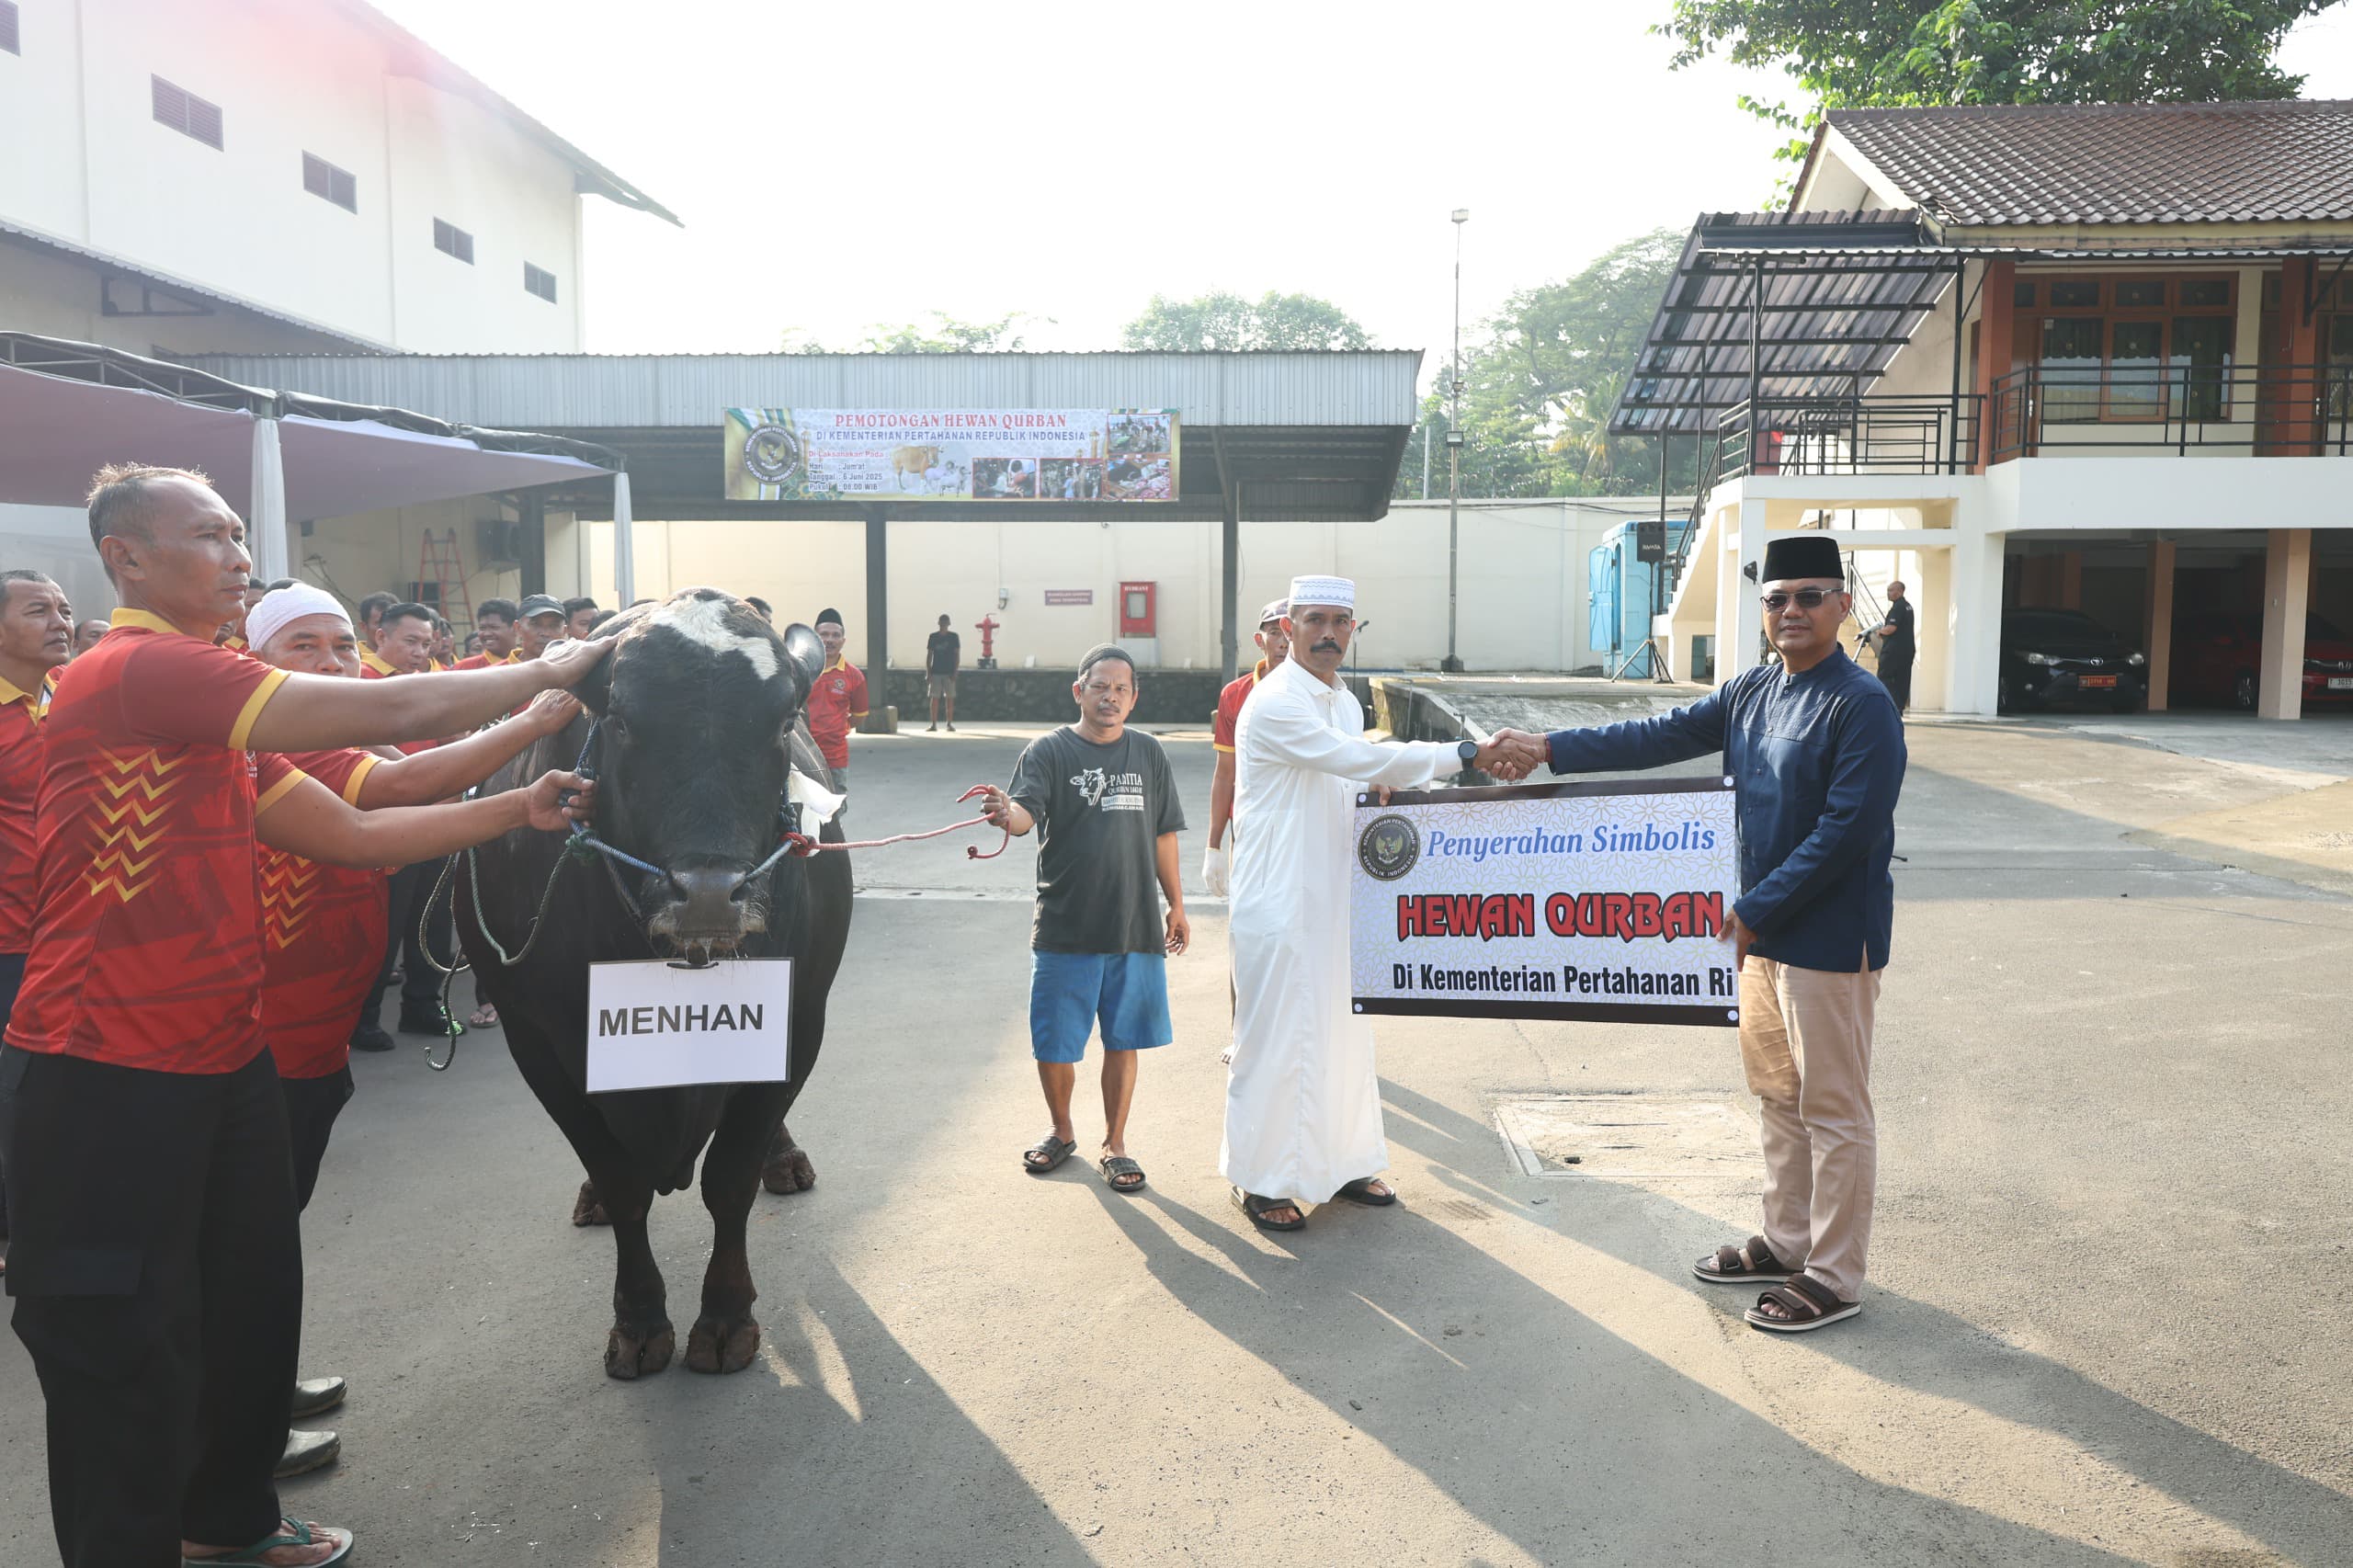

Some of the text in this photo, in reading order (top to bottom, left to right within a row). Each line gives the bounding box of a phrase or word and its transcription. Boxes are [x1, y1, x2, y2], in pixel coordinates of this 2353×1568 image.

[816, 431, 1086, 440] DI KEMENTERIAN PERTAHANAN REPUBLIK INDONESIA
[835, 415, 1066, 429] PEMOTONGAN HEWAN QURBAN
[1109, 773, 1142, 787] PANITIA
[1427, 822, 1715, 862] Penyerahan Simbolis
[1396, 892, 1724, 943] HEWAN QURBAN
[1392, 963, 1733, 996] Di Kementerian Pertahanan Ri
[598, 1003, 764, 1037] MENHAN
